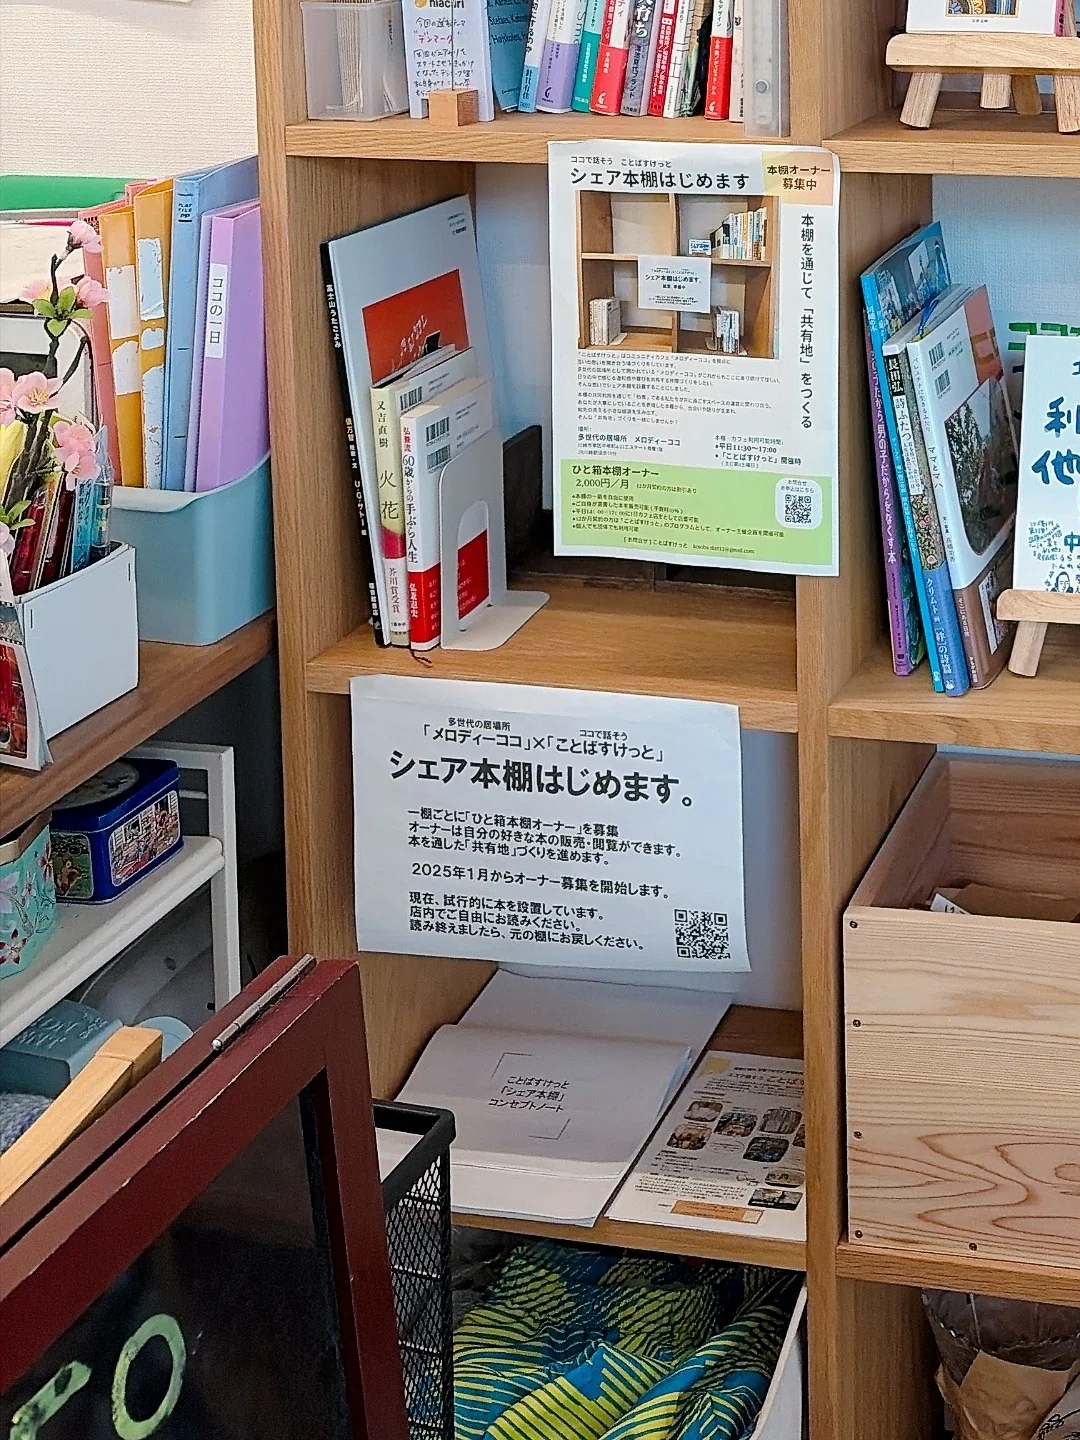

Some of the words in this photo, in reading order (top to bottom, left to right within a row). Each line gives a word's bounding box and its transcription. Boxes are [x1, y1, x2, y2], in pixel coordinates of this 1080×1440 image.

[571, 156, 613, 165] ココで話そう
[621, 158, 672, 168] ことばすけっと
[766, 165, 831, 176] 本棚オーナー
[570, 167, 750, 190] シェア本棚はじめます
[782, 178, 817, 191] 募集中
[210, 278, 224, 344] ココの一日
[800, 213, 815, 429] 本棚を通じて「共有地」をつくる
[888, 358, 904, 392] 長田弘
[345, 418, 355, 442] 俵万智
[376, 400, 389, 448] 又吉直樹
[895, 398, 912, 441] 詩ふたつ
[403, 426, 412, 453] 弘兼流
[577, 433, 627, 443] 多世代の居場所
[634, 436, 681, 446] メロディーココ
[572, 465, 660, 477] ひと箱本棚オーナー
[379, 471, 399, 520] 火花
[402, 455, 418, 564] 60歳からの手ぶら人生
[388, 567, 400, 614] 芥川賞受賞
[408, 582, 419, 619] 弘兼憲史
[926, 578, 939, 615] クリムト
[448, 717, 511, 732] 多世代の居場所
[579, 729, 628, 742] ココで話そう
[389, 750, 693, 808] シェア本棚はじめます。
[408, 807, 619, 838] 一棚ごとに「ひと箱本棚オーナー」を募集
[408, 835, 609, 865] 本を通した「共有地」づくりを進めます。
[409, 821, 682, 858] オーナーは自分の好きな本の販売・閲覧ができます。
[411, 863, 669, 899] 2025年1月からオーナー募集を開始します。
[409, 891, 605, 920] 現在、試行的に本を設置しています。
[409, 906, 581, 932] 店内でご自由にお読みください。
[409, 918, 645, 951] 読み終えましたら、元の棚にお戻しください。
[500, 1086, 565, 1102] 「シェア本棚」
[507, 1075, 570, 1090] ことばすけっと
[488, 1097, 564, 1113] コンセプトノート
